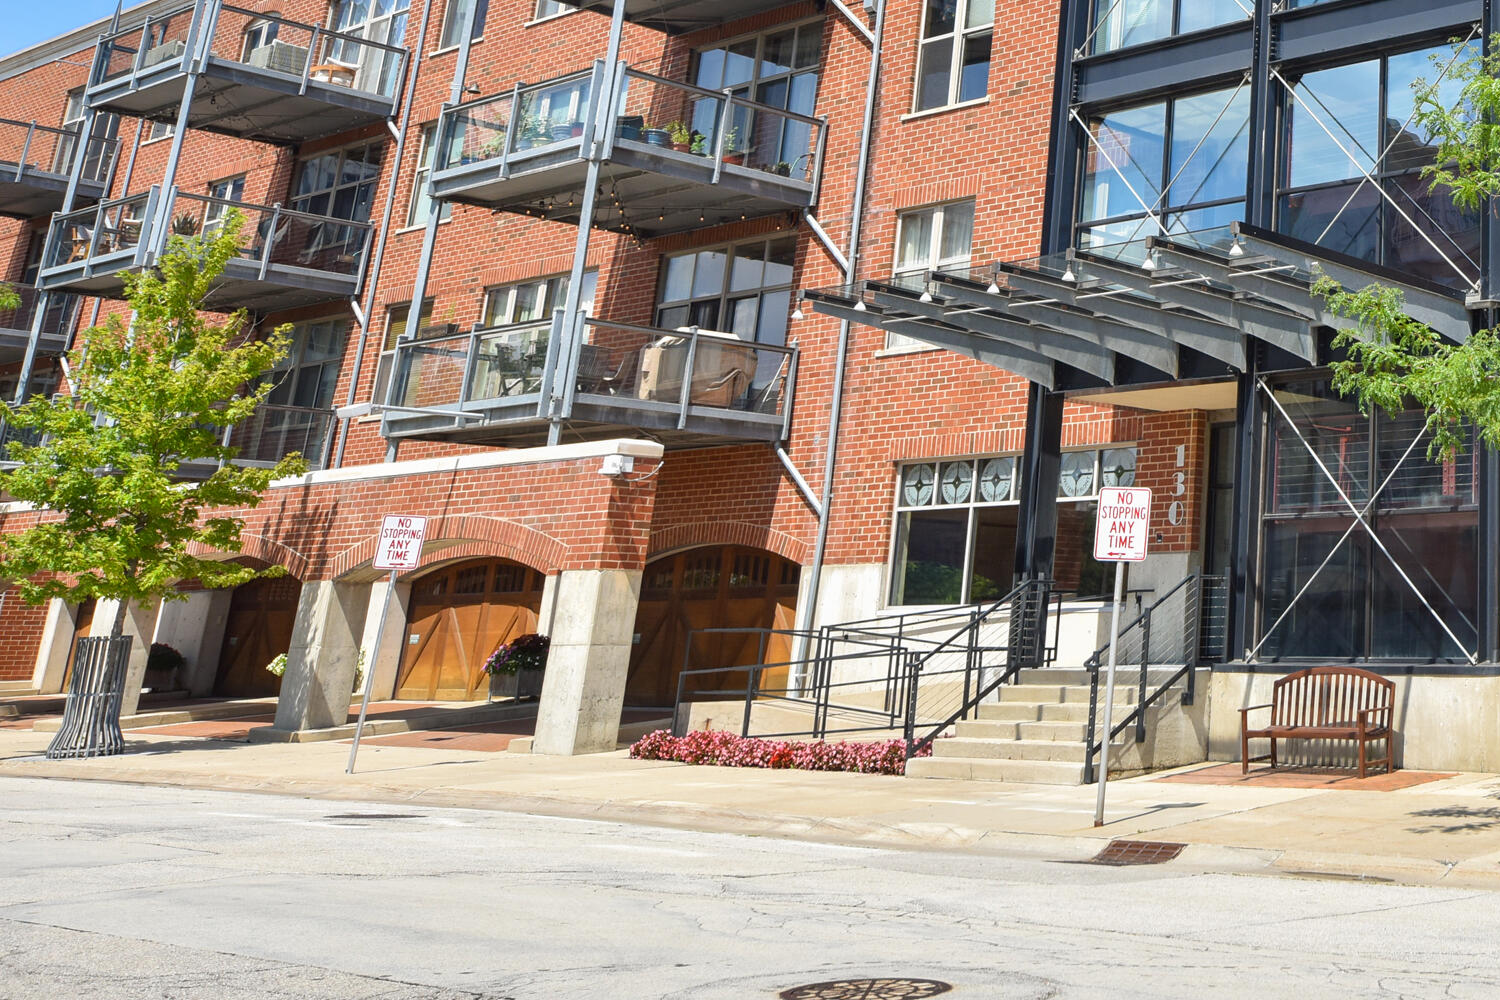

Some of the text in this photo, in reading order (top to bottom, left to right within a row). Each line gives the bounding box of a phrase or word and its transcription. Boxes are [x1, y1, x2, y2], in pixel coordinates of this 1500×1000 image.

[1168, 444, 1186, 526] 130
[1117, 492, 1134, 505] NO
[1102, 505, 1146, 520] STOPPING
[398, 518, 411, 528] NO
[1109, 520, 1135, 534] ANY
[384, 528, 421, 539] STOPPING
[389, 540, 411, 549] ANY
[1108, 535, 1135, 549] TIME
[387, 550, 409, 560] TIME
